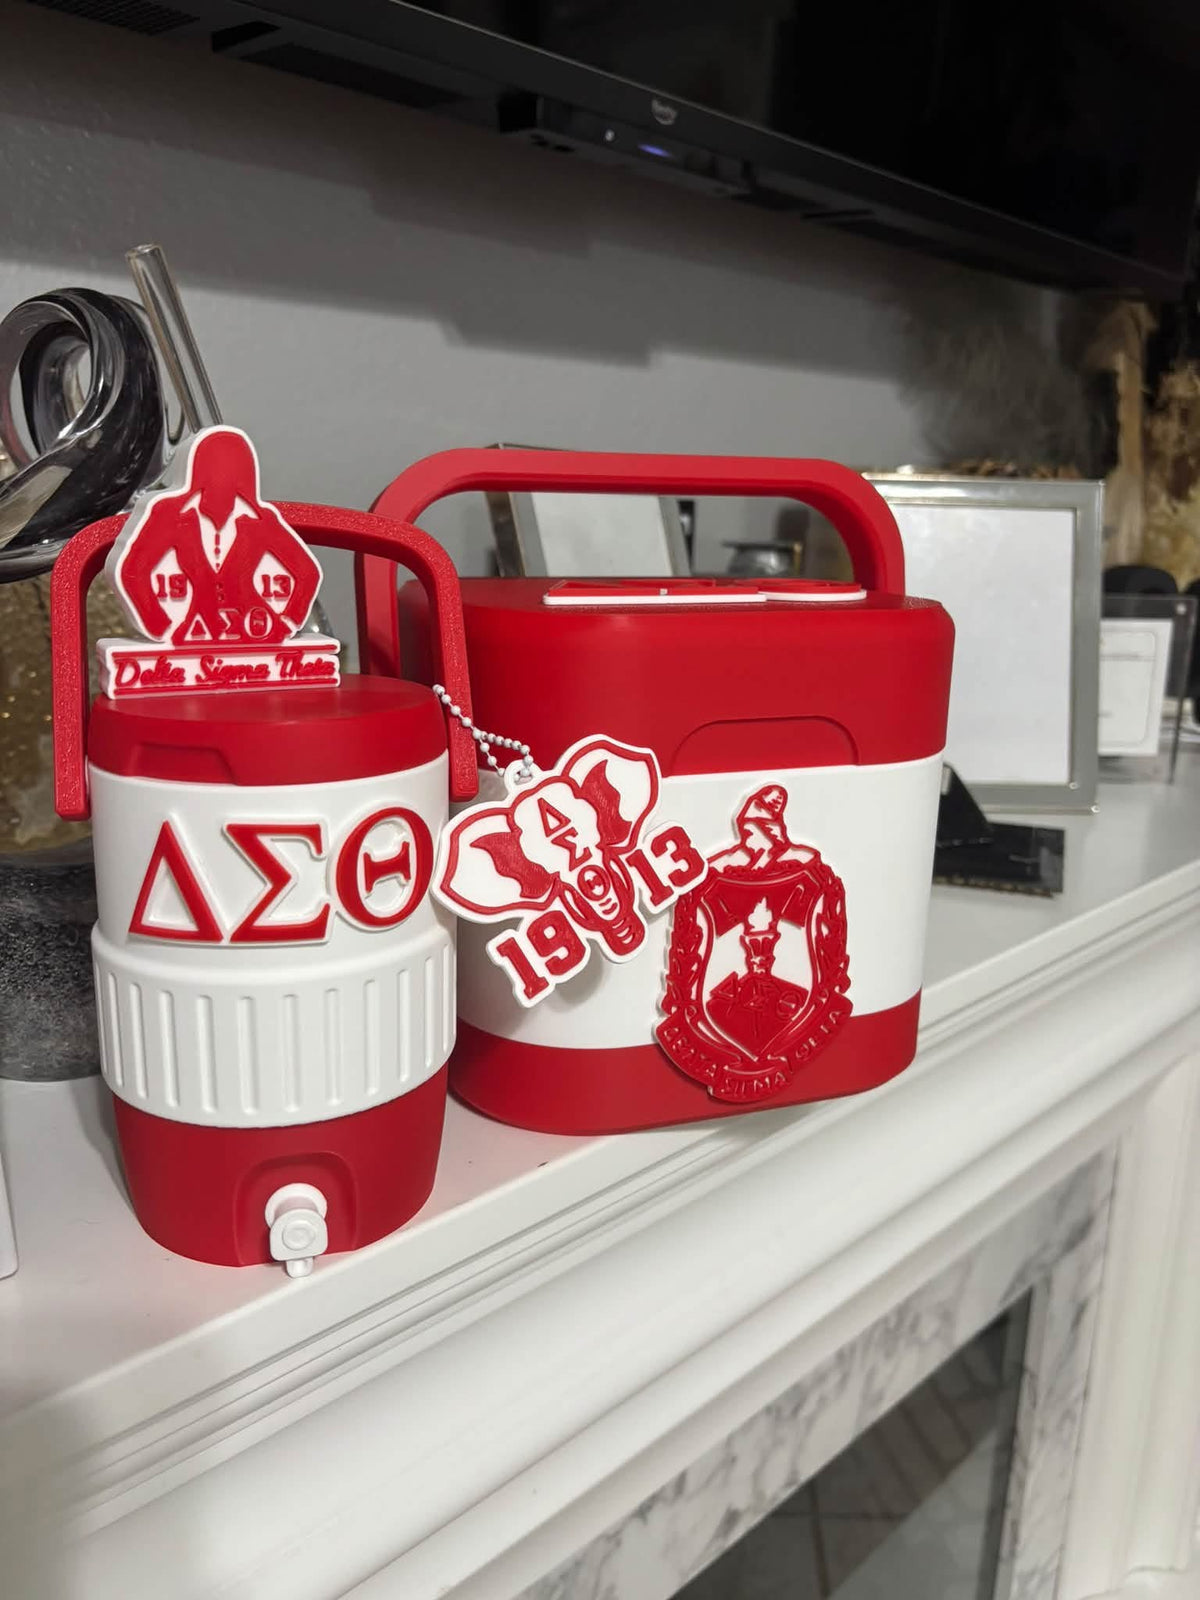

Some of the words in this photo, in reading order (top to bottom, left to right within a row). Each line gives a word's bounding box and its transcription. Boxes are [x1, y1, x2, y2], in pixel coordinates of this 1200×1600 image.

[155, 573, 188, 599] 19
[261, 574, 291, 599] 13
[113, 655, 186, 688] Delta
[195, 654, 271, 689] Sigma
[275, 651, 335, 677] Theta
[625, 825, 706, 907] 13
[495, 909, 586, 1000] 19
